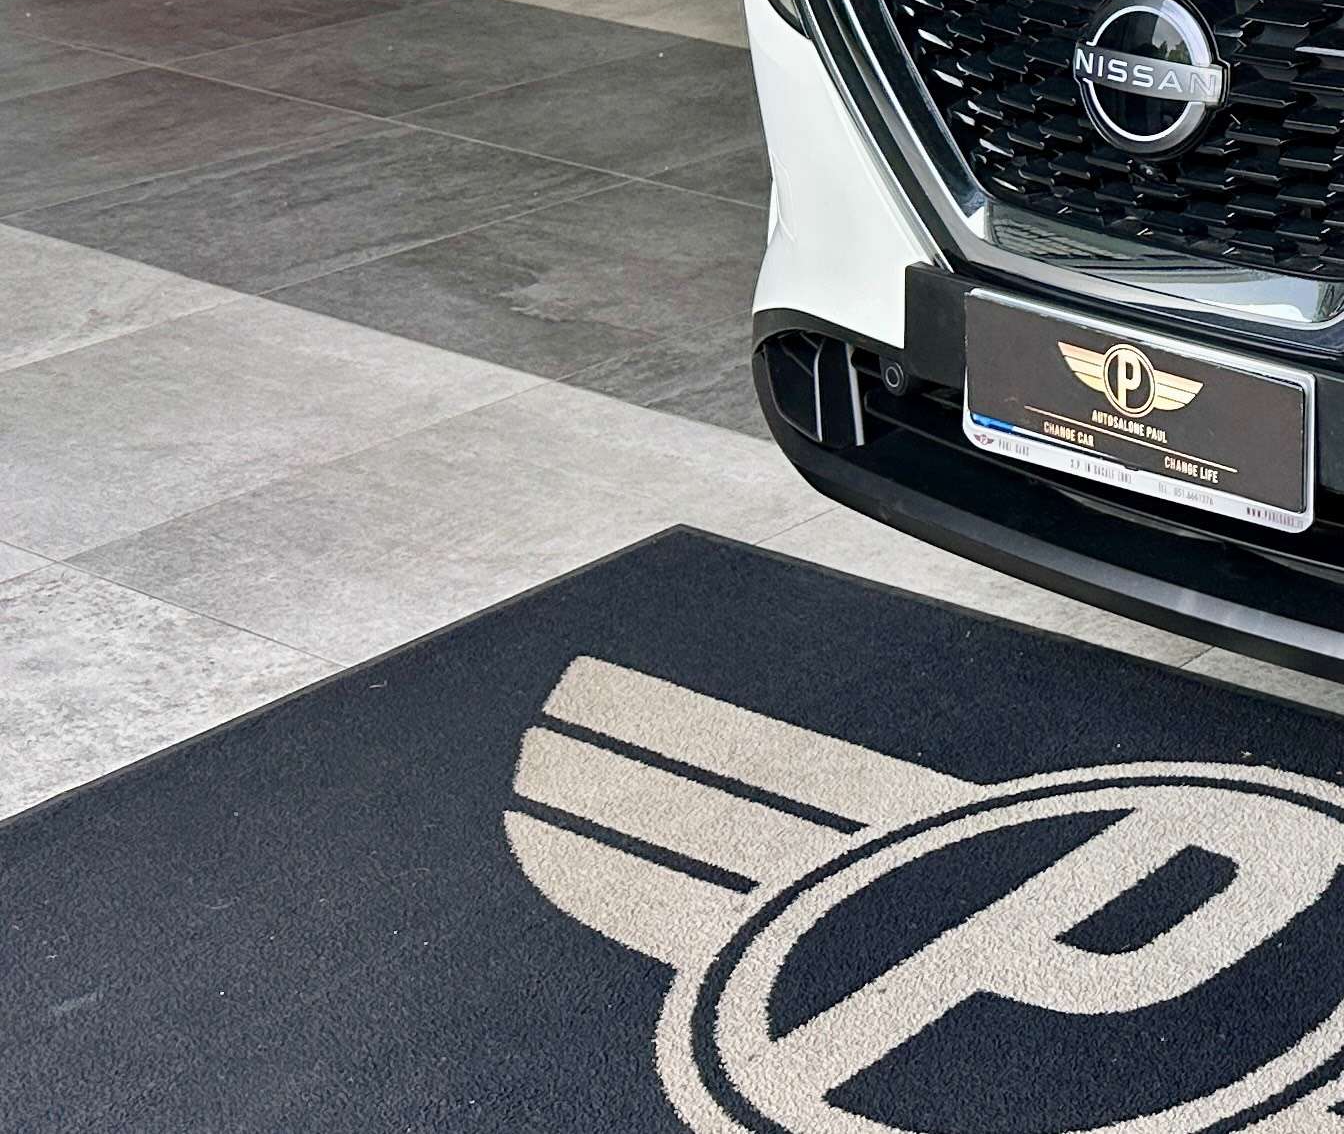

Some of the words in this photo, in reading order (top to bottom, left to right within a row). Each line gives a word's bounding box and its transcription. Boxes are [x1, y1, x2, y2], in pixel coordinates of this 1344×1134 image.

[1075, 48, 1217, 96] NISSAN
[1043, 421, 1076, 441] CHANGE
[1077, 431, 1095, 448] CAR
[1091, 409, 1145, 437] AUTOSALONE
[1146, 425, 1168, 444] PAUL
[1164, 455, 1199, 478] CHANGE
[1199, 466, 1219, 484] LIFE
